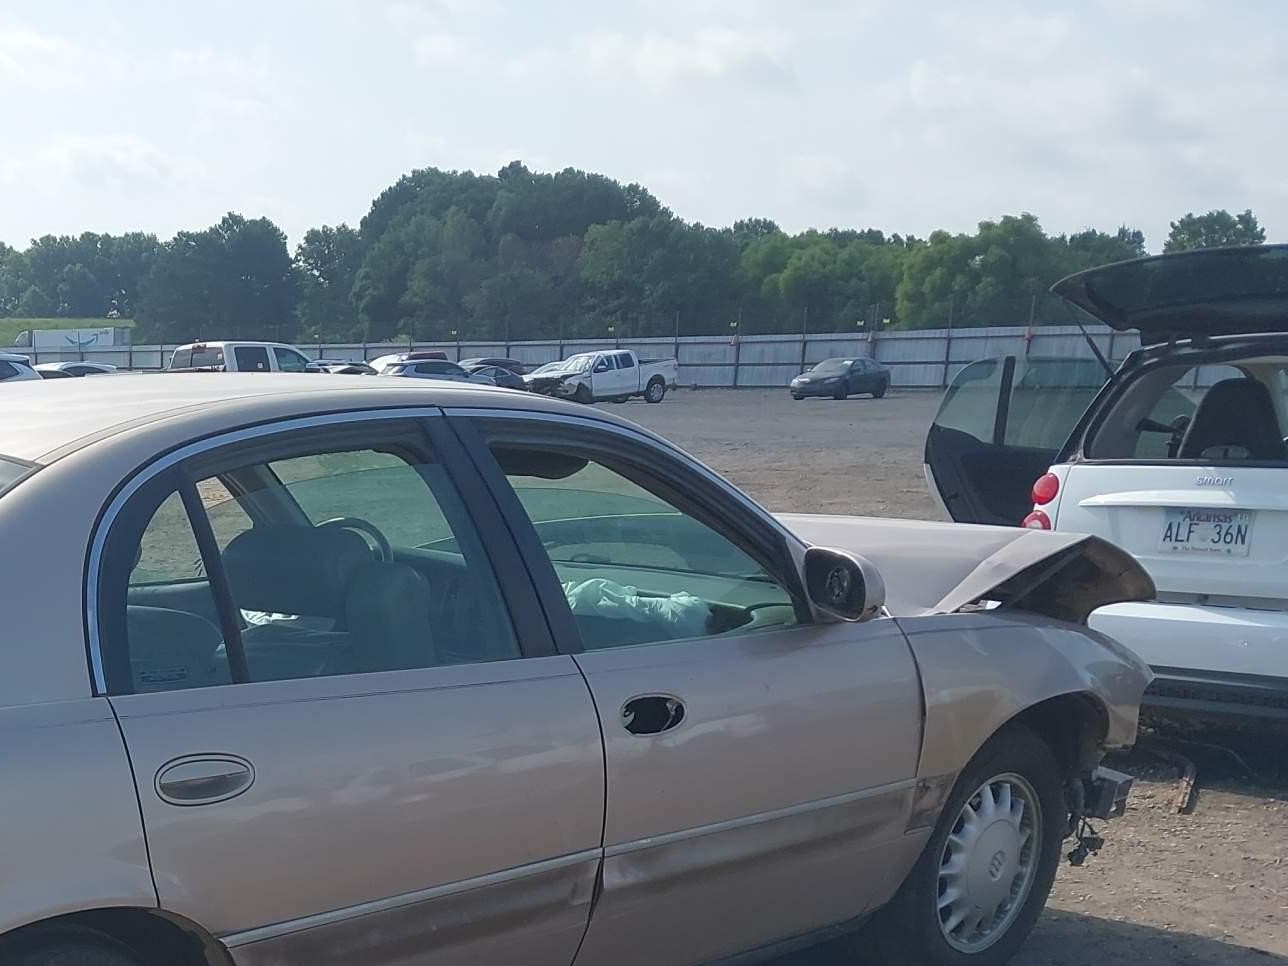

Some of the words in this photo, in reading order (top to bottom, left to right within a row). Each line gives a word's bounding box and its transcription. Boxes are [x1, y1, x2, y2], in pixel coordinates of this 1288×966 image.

[1195, 475, 1234, 487] smart
[1162, 522, 1200, 543] ALF
[1211, 523, 1249, 545] 36N
